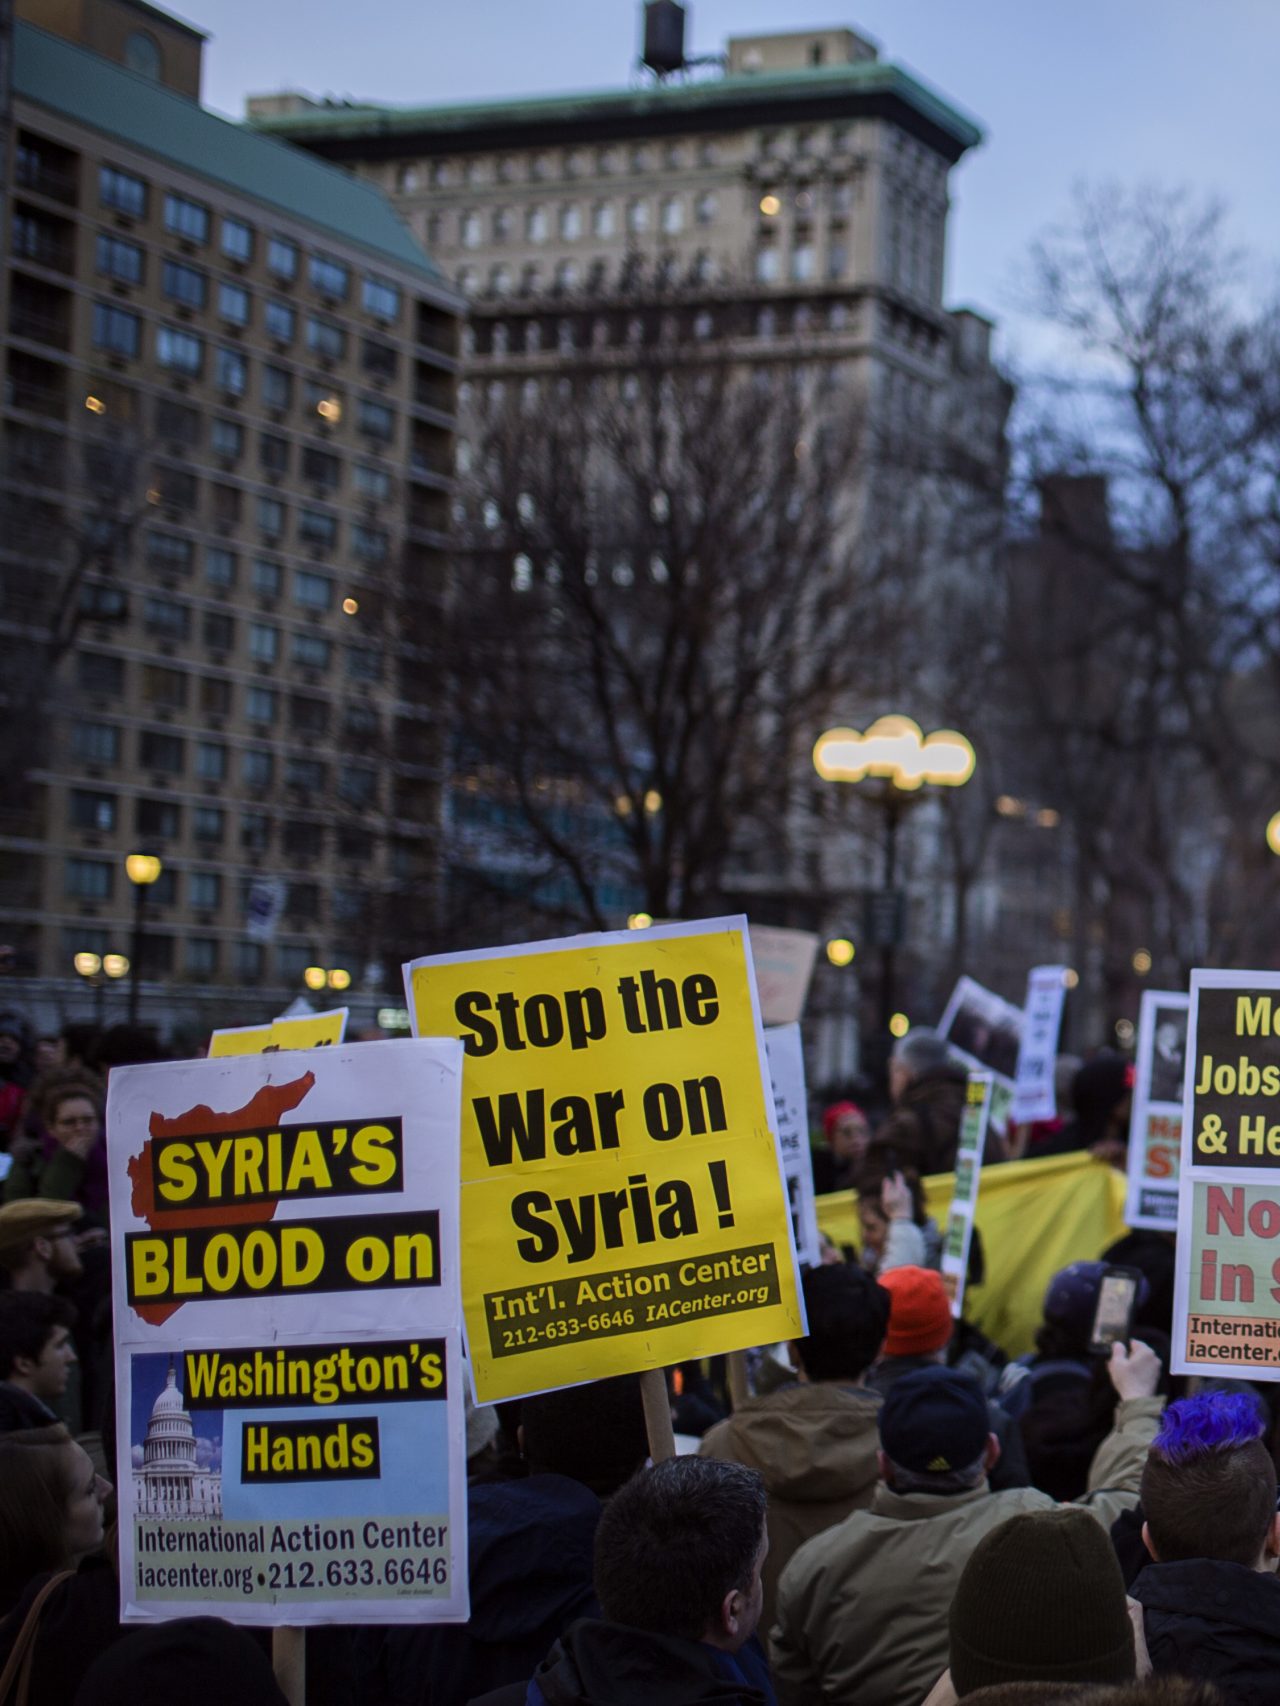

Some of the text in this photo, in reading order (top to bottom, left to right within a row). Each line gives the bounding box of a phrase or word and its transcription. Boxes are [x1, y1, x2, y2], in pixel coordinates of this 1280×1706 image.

[454, 985, 607, 1057] Stop
[617, 969, 719, 1034] the
[472, 1075, 728, 1167] War on
[1197, 1113, 1228, 1154] &
[158, 1125, 396, 1202] SYRIA'S
[132, 1227, 433, 1297] BLOOD on
[491, 1251, 772, 1322] Int'l. Action Center
[1200, 1249, 1255, 1302] in
[502, 1285, 769, 1348] 212-633-6646 IACenter.org
[186, 1344, 443, 1404] Washington's
[247, 1423, 374, 1472] Hands
[138, 1520, 448, 1553] International Action Center
[138, 1562, 254, 1594] iacenter.org
